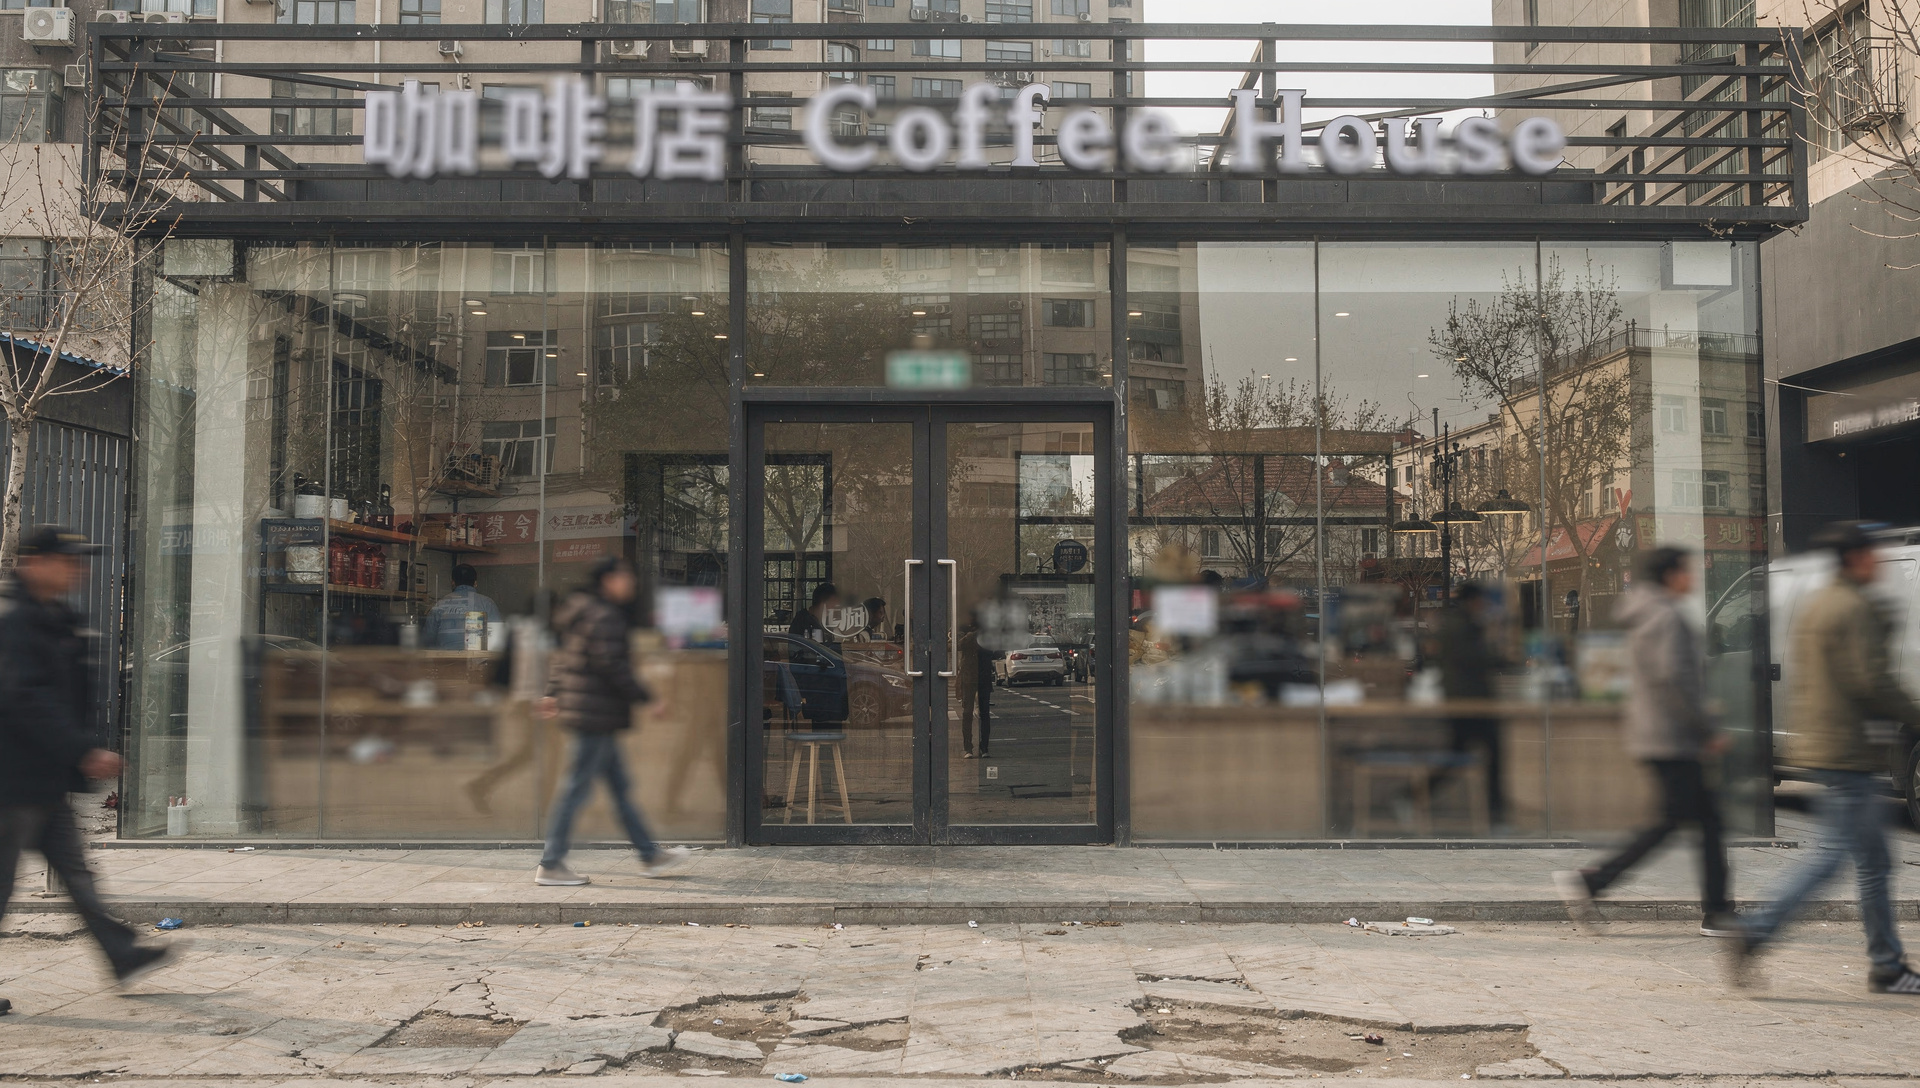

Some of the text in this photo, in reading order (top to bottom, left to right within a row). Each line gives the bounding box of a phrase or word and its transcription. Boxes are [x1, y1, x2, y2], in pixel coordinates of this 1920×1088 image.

[364, 77, 732, 181] 咖啡店
[803, 83, 1566, 175] Coffee House
